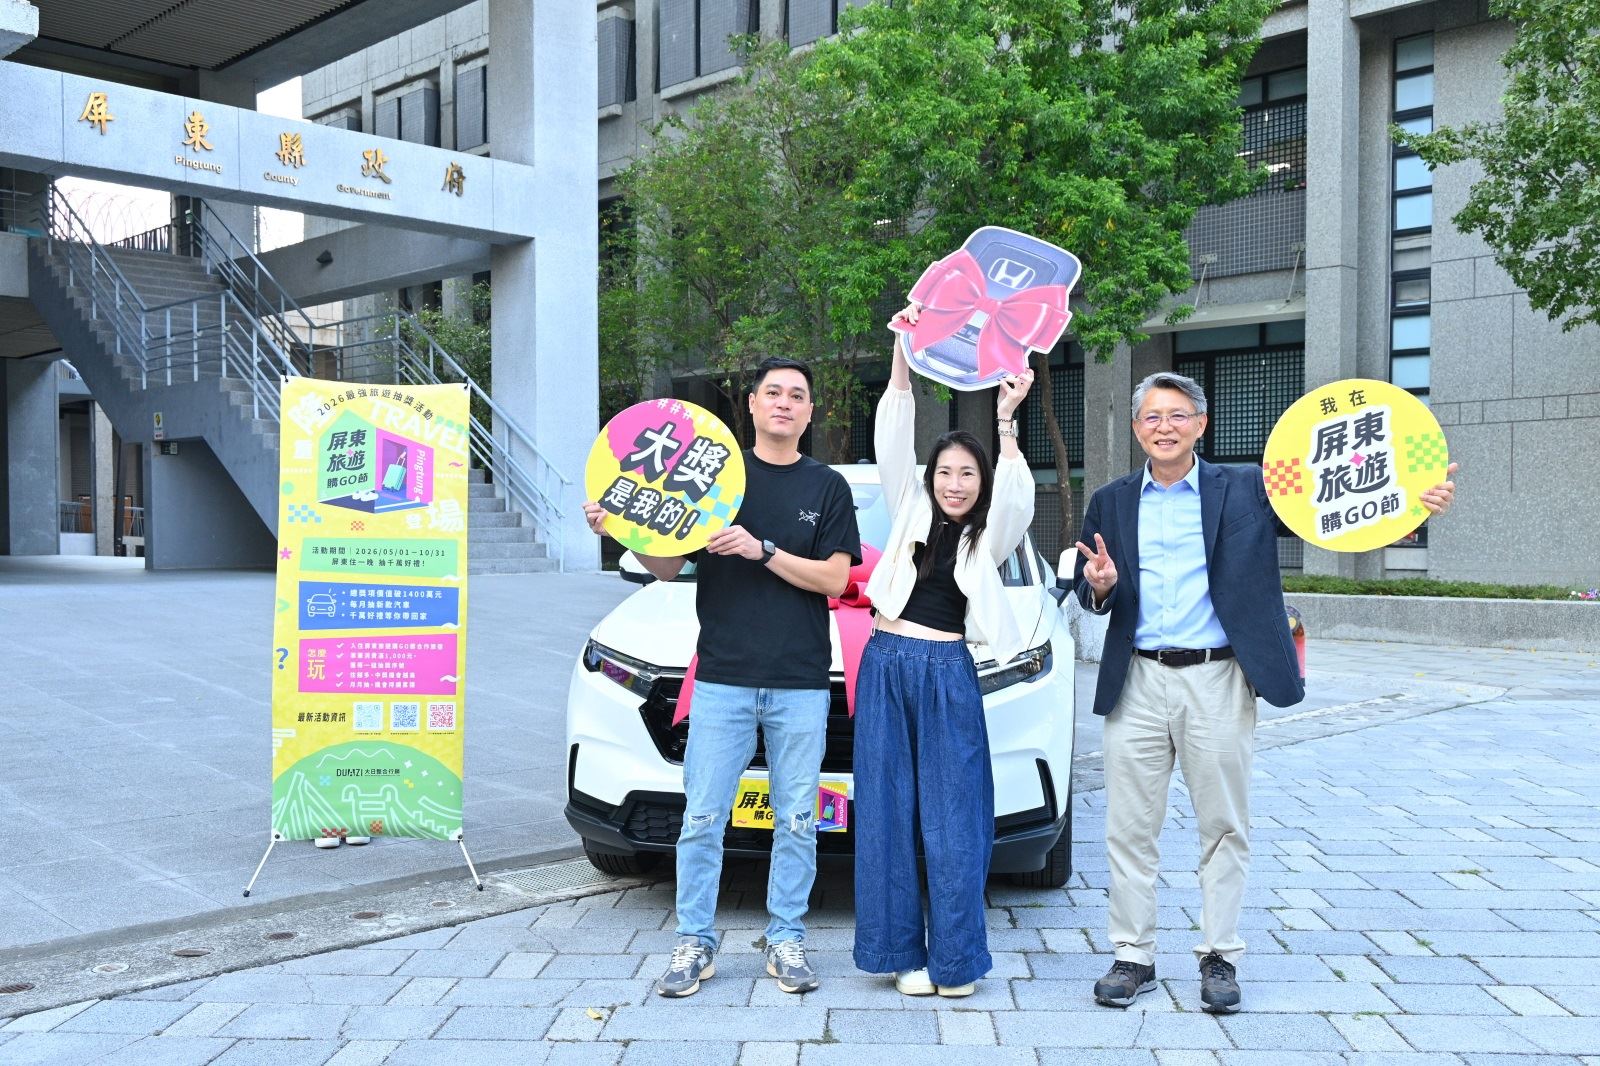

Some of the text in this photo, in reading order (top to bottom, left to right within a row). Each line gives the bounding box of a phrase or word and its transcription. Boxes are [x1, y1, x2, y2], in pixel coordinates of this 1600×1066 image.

[79, 92, 467, 198] 屏東縣政府
[174, 154, 392, 201] Pingtung County Government
[317, 388, 433, 420] 2026最強旅遊抽獎活動
[1320, 389, 1366, 415] 我在
[326, 429, 367, 452] 屏東
[1312, 411, 1386, 464] 屏東
[326, 451, 365, 473] 旅遊
[413, 449, 426, 495] Pingtung
[625, 422, 729, 497] 大獎
[1317, 451, 1390, 503] 旅遊
[327, 473, 368, 489] 購GO節
[1321, 493, 1400, 534] 購GO節
[307, 659, 326, 680] 玩
[297, 712, 346, 723] 最新活動資訊
